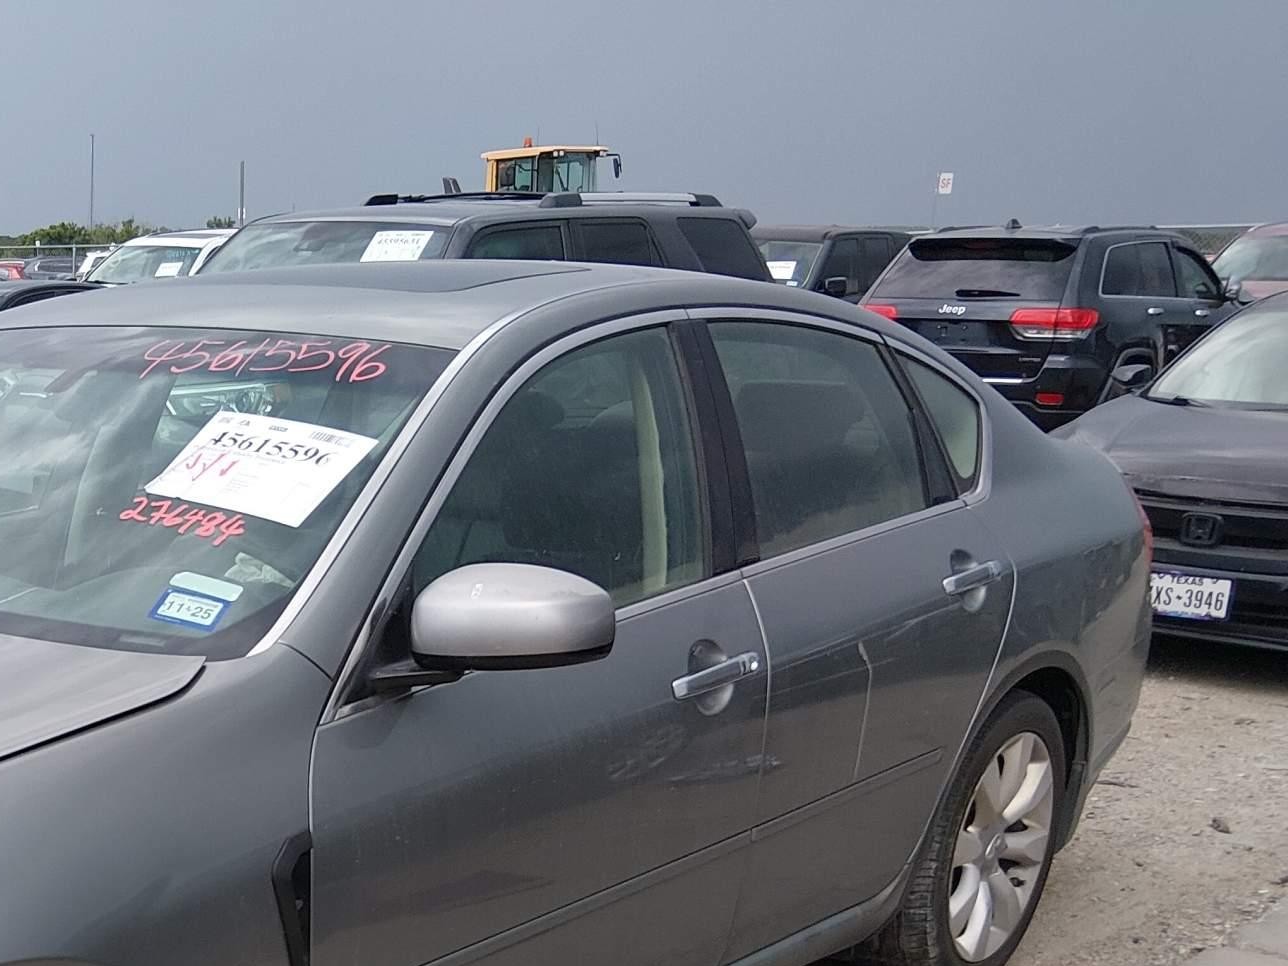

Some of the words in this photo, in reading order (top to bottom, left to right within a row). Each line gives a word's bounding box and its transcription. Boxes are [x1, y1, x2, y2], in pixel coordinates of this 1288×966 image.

[938, 304, 967, 316] Jeep
[139, 338, 393, 384] 45615596
[212, 430, 337, 466] 45615596
[119, 496, 246, 547] 276484
[1171, 575, 1204, 586] TEXAS
[1150, 585, 1225, 612] XS-3946
